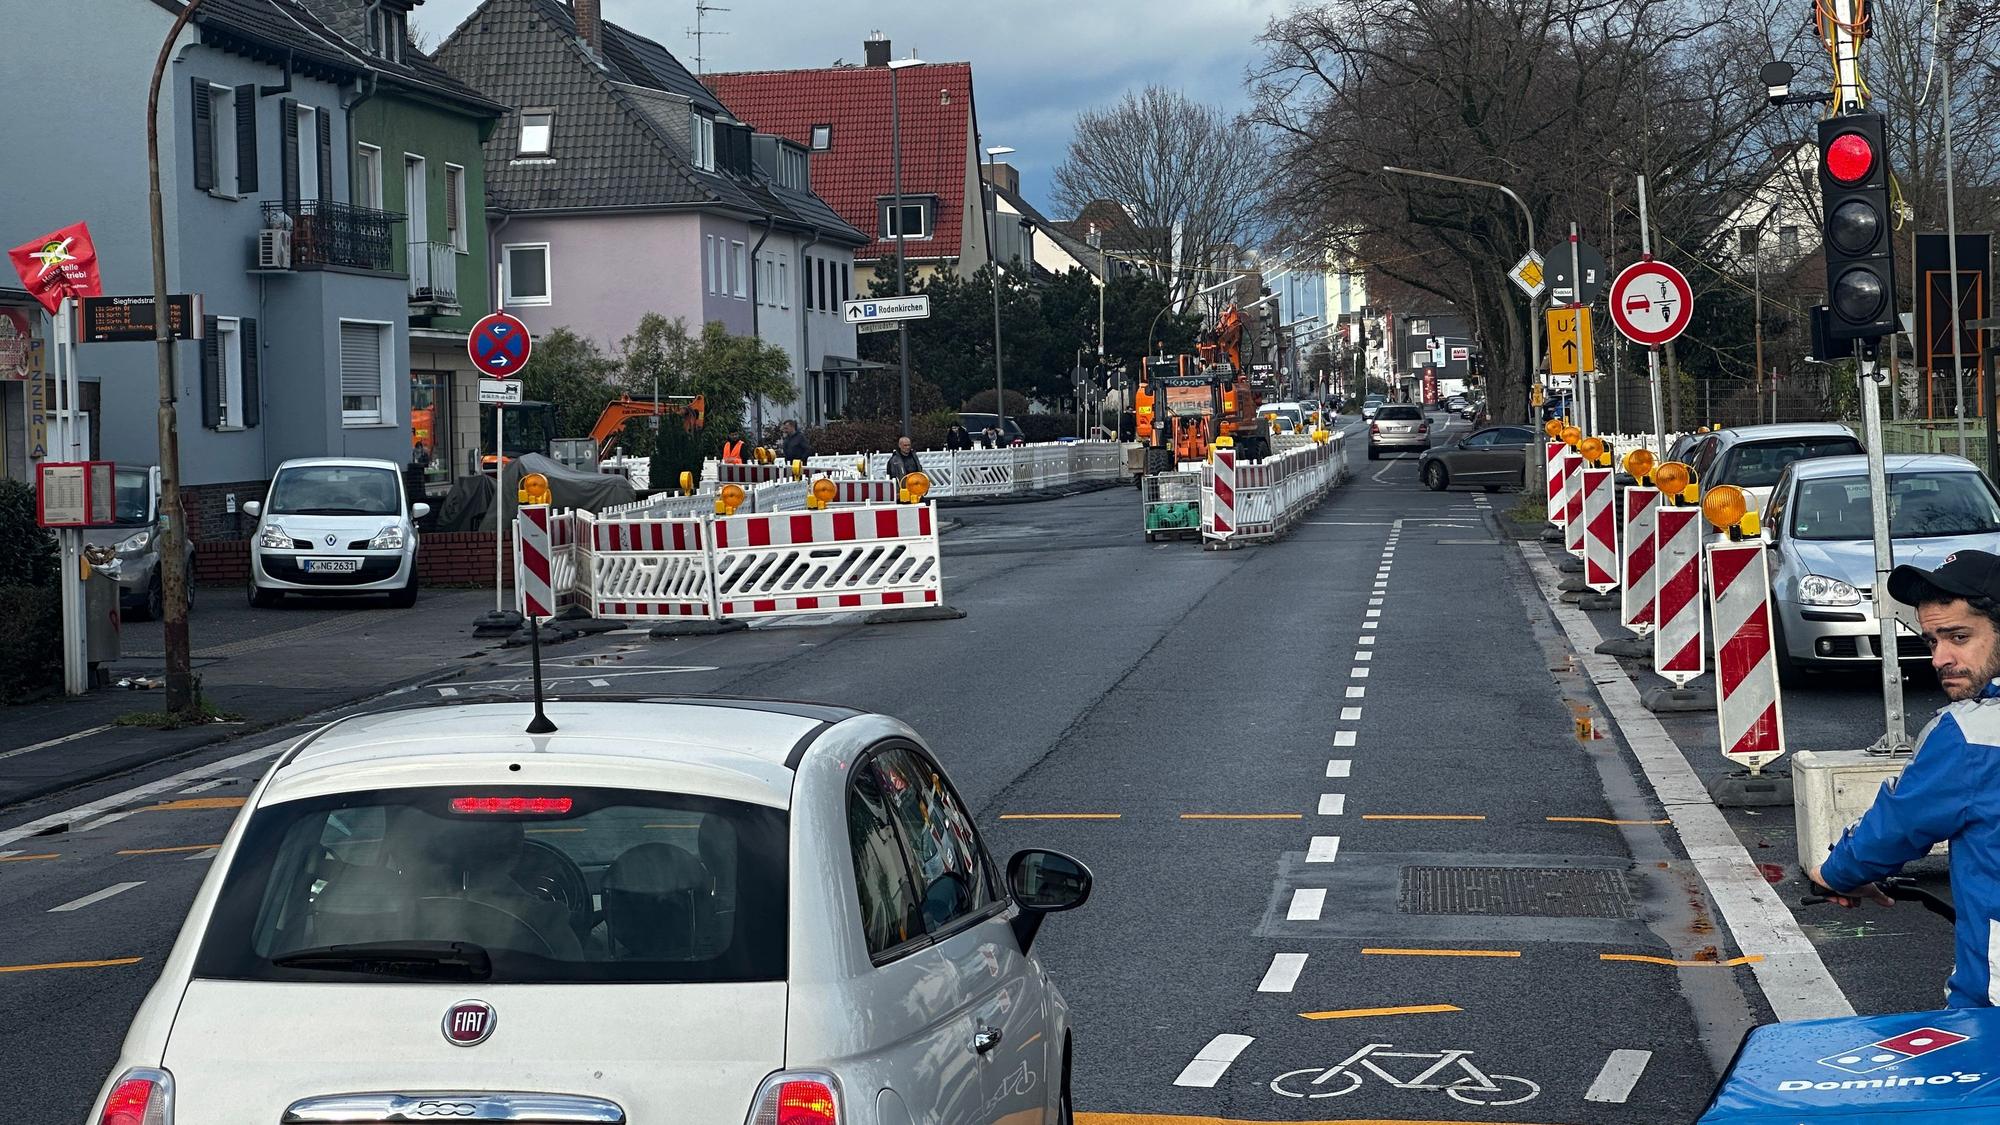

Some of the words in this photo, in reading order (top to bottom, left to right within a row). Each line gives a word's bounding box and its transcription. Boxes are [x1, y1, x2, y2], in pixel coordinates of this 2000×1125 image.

[113, 298, 156, 306] Siegfriedstra
[866, 305, 874, 316] P
[879, 304, 923, 314] Rodenkirchen
[31, 341, 45, 454] PIZZERIA
[321, 562, 332, 570] NG
[333, 562, 354, 570] 2631
[454, 1011, 485, 1032] FIAT
[1778, 1071, 1981, 1091] Domino's
[418, 1101, 476, 1116] 500
